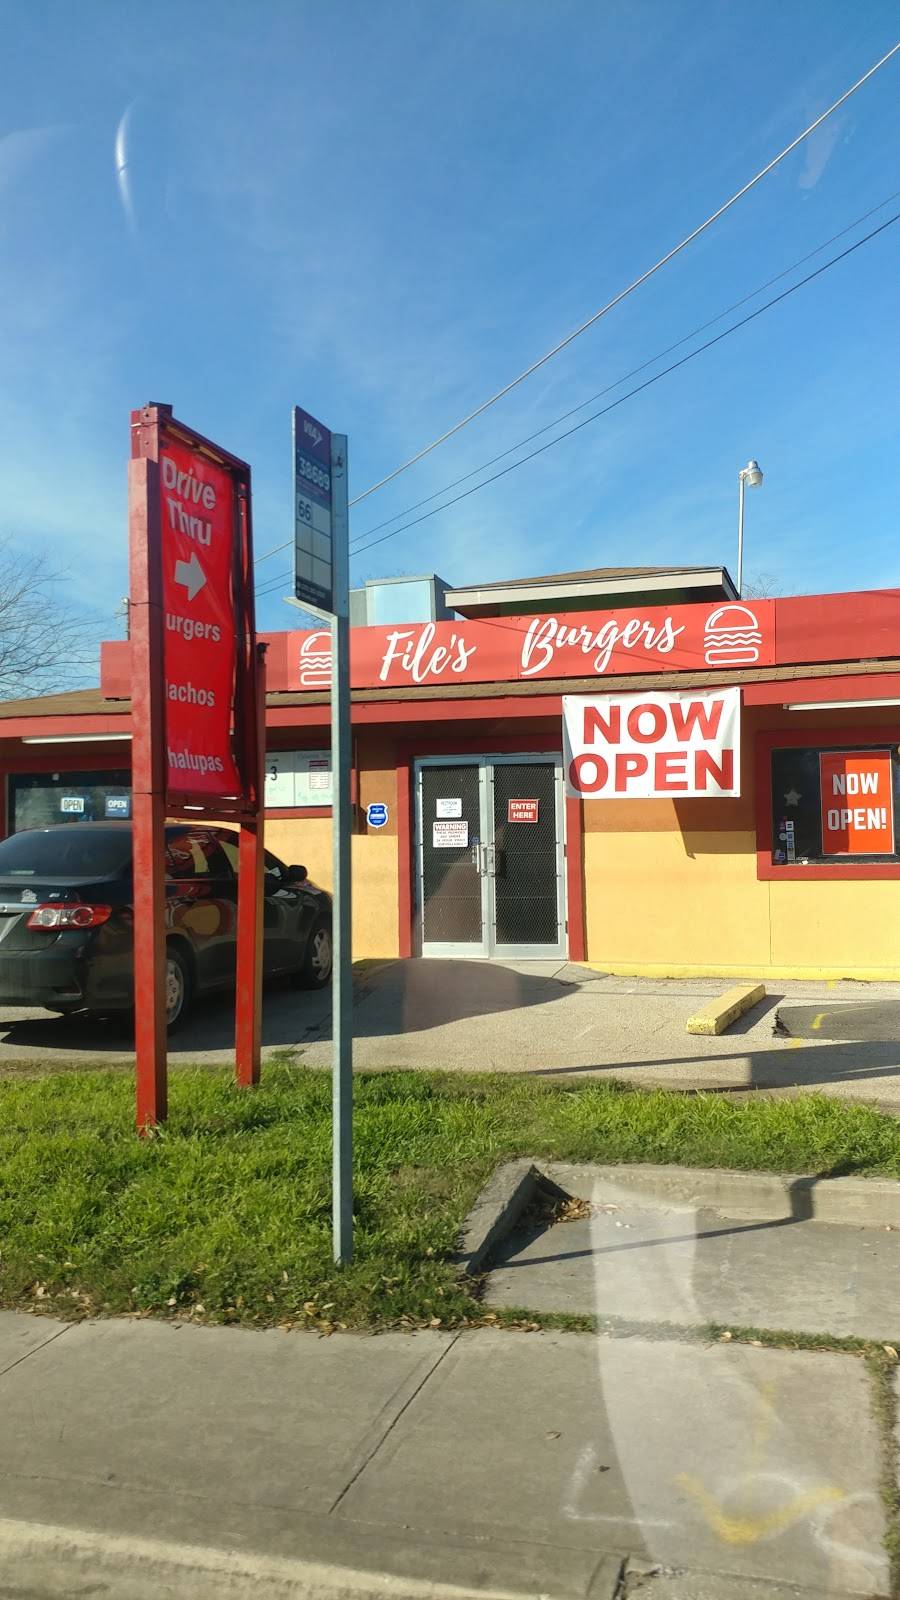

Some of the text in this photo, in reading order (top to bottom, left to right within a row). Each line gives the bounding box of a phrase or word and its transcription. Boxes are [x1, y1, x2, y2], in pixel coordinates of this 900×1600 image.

[162, 455, 216, 510] Drive
[167, 497, 212, 546] Thru
[298, 500, 311, 521] 66
[379, 616, 685, 682] File's Burgers
[165, 678, 215, 707] achos
[583, 700, 725, 744] NOW
[569, 749, 734, 793] OPEN
[832, 772, 878, 796] NOW
[107, 800, 127, 808] OPEN
[512, 811, 534, 819] HERE
[435, 823, 467, 831] WARNING
[827, 807, 887, 831] OPEN!
